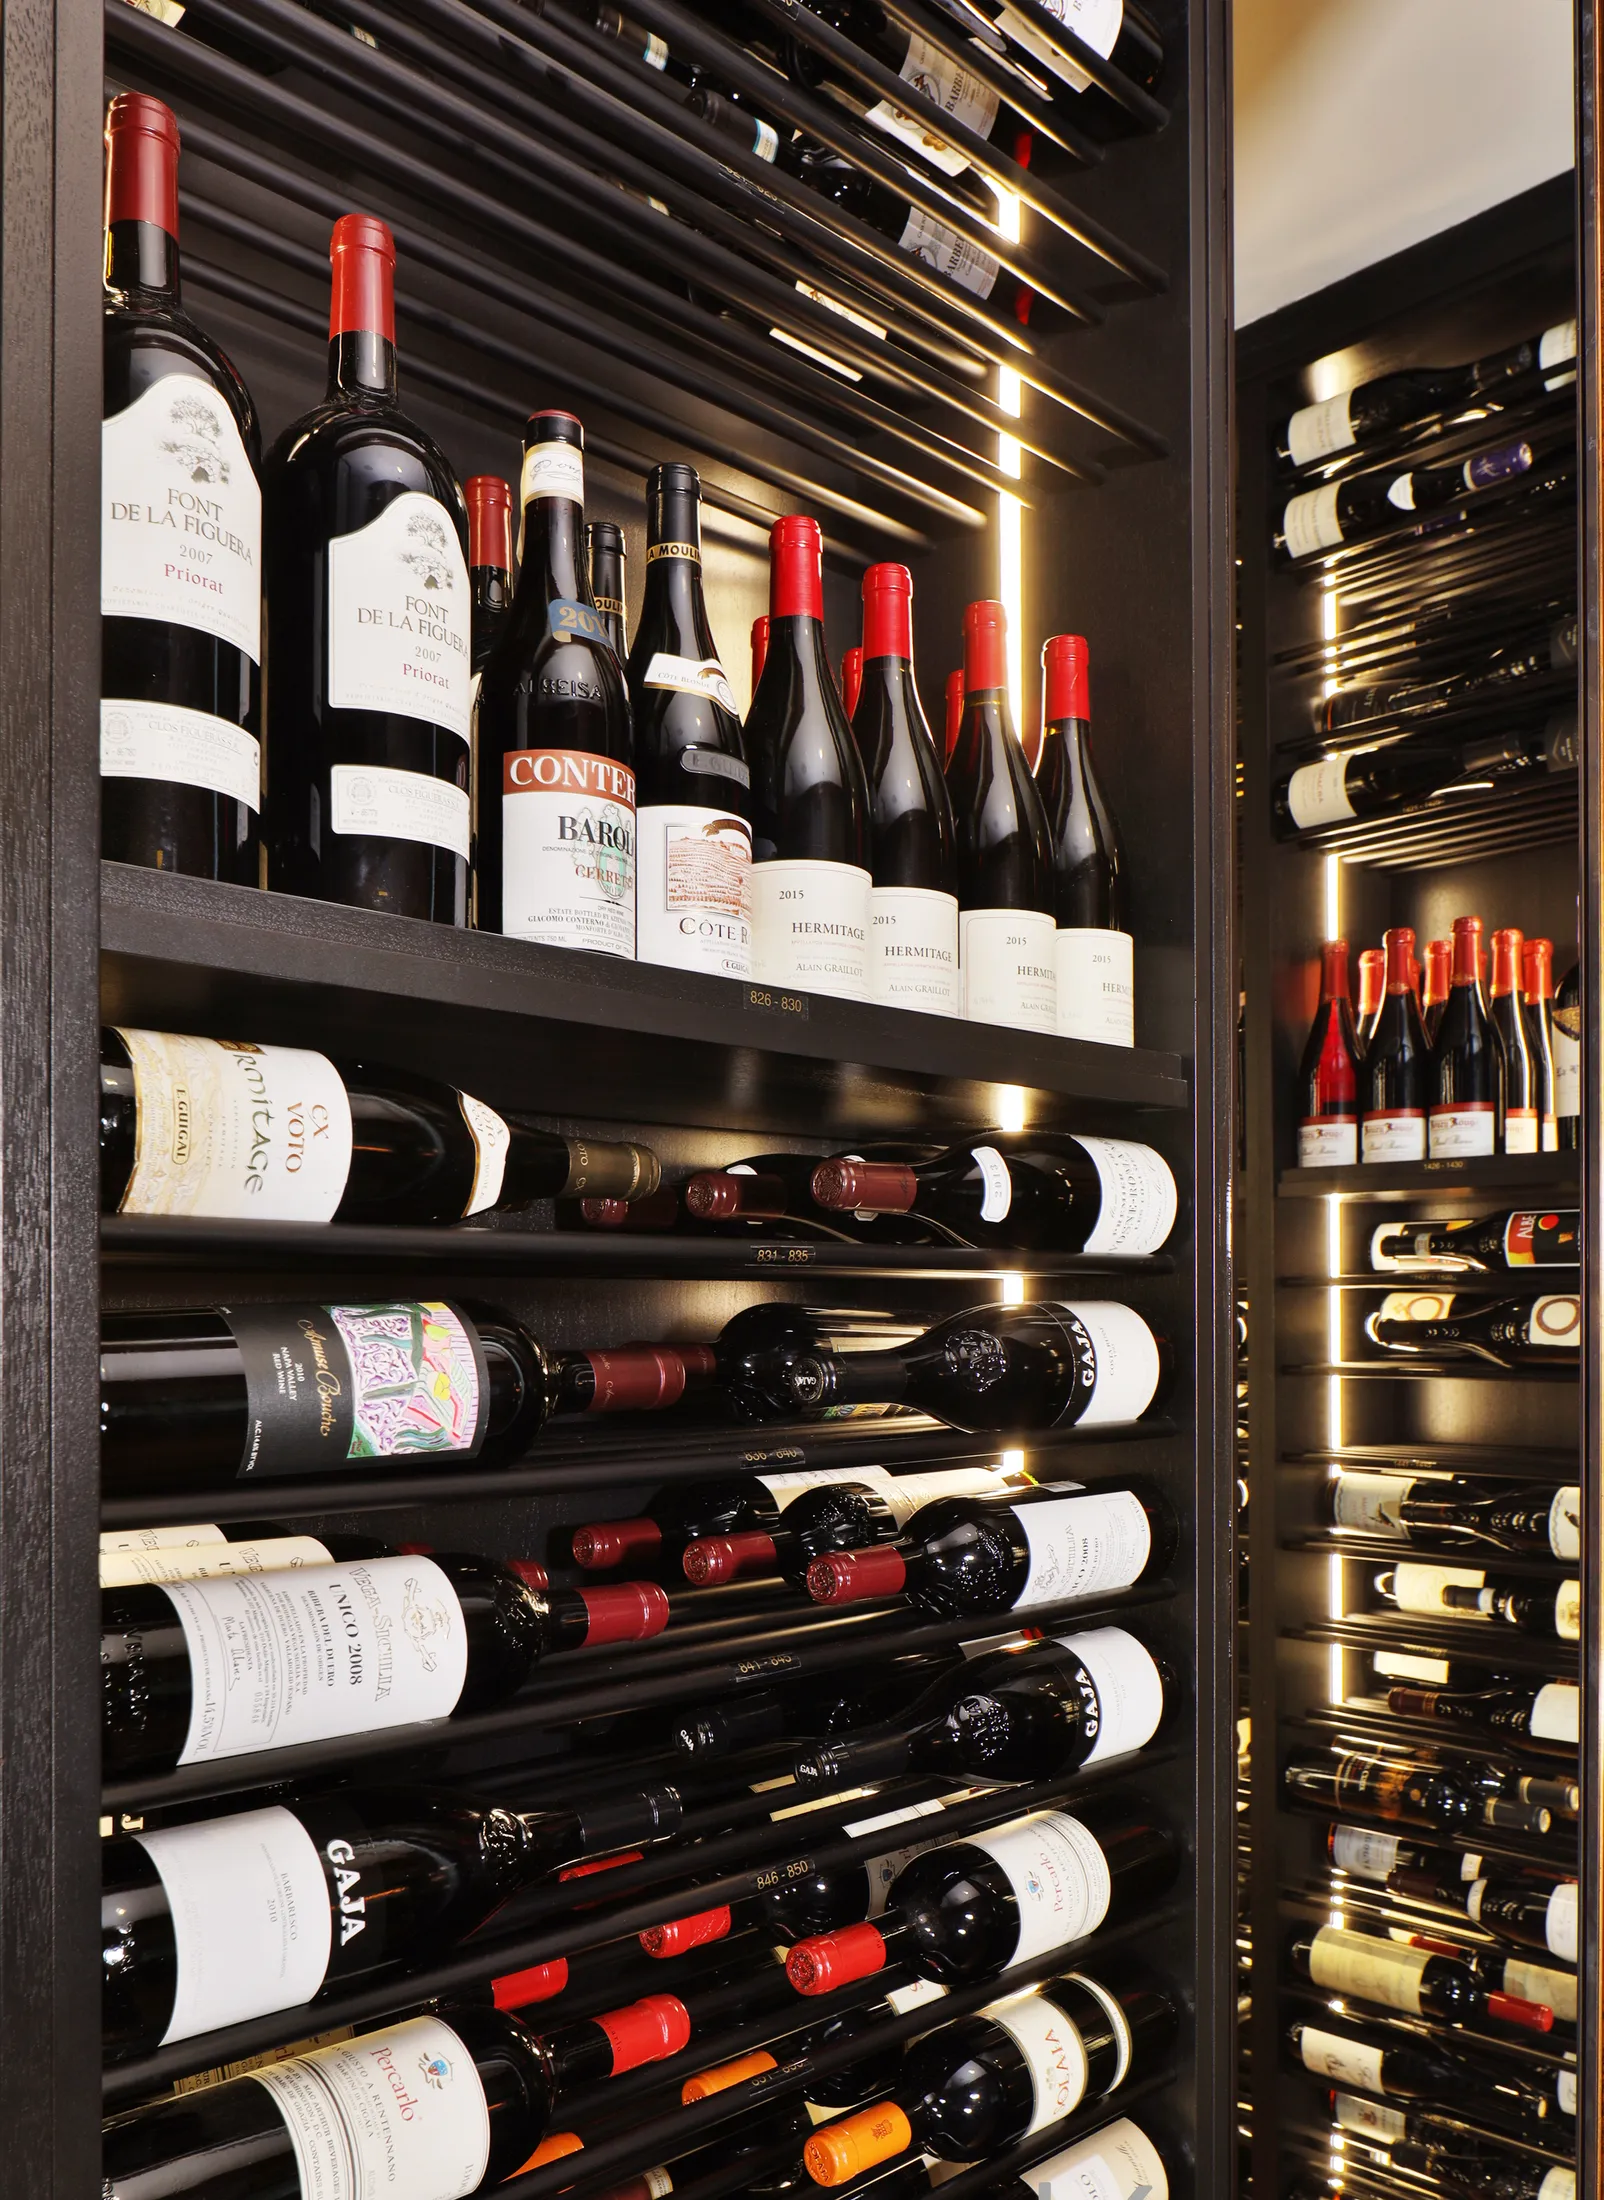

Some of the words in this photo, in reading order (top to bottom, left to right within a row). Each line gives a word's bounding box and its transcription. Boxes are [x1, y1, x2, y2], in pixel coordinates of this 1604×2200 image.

[167, 488, 224, 523] FONT
[111, 502, 141, 523] DE
[146, 505, 177, 528] LA
[183, 514, 254, 566] FIGUERA
[179, 544, 214, 566] 2007
[164, 563, 224, 595] Priorat
[404, 594, 449, 625] FONT
[357, 607, 384, 625] DE
[389, 611, 414, 632] LA
[418, 618, 469, 661] FIGUERA
[414, 646, 442, 663] 2007
[402, 663, 450, 690] Priorat
[778, 889, 805, 900] 2015
[528, 915, 564, 923] GIACOMO
[566, 916, 604, 927] CONTERNO
[791, 921, 866, 942] HERMITAGE
[872, 915, 897, 925] 2015
[884, 946, 953, 963] HERMITAGE
[1006, 936, 1027, 946] 2015
[795, 963, 822, 972] ALAIN
[824, 963, 864, 978] GRAILLOT
[1092, 954, 1112, 964] 2015
[750, 990, 772, 1006] 826
[779, 997, 803, 1013] 830
[888, 984, 913, 992] ALAIN
[915, 984, 951, 997] GRAILLOT
[285, 1101, 305, 1173] VOTO
[756, 1249, 778, 1262] 831
[787, 1249, 809, 1262] 835
[272, 1353, 282, 1369] RED
[280, 1346, 293, 1368] NAPA
[1070, 1320, 1096, 1387] GAJA
[276, 1370, 286, 1394] WINE
[286, 1369, 298, 1401] VALLEY
[295, 1362, 305, 1382] 2010
[297, 1319, 328, 1369] Amuse
[315, 1370, 342, 1437] Bouche
[1081, 1537, 1090, 1566] 2008
[307, 1590, 327, 1622] RIBERA
[321, 1624, 332, 1647] DEL
[329, 1583, 360, 1638] UNICO
[347, 1643, 363, 1686] 2008
[325, 1648, 335, 1687] DUERO
[1075, 1667, 1100, 1738] GAJA
[680, 1729, 695, 1751] GAJA
[799, 1765, 818, 1777] GAJA
[756, 1870, 779, 1890] 846
[786, 1860, 809, 1880] 850
[1039, 1851, 1064, 1912] Percarlo
[326, 1838, 366, 1946] GAJA
[266, 1898, 278, 1923] 2010
[280, 1872, 298, 1941] BARBARESCO
[369, 2047, 419, 2122] Percarlo
[342, 2051, 369, 2078] GIUSTO
[367, 2082, 374, 2090] A
[372, 2094, 396, 2182] RENTENNANO
[313, 2102, 331, 2139] ARTHUR
[326, 2139, 341, 2194] BEVERAGES
[308, 2139, 324, 2188] CONTAINS
